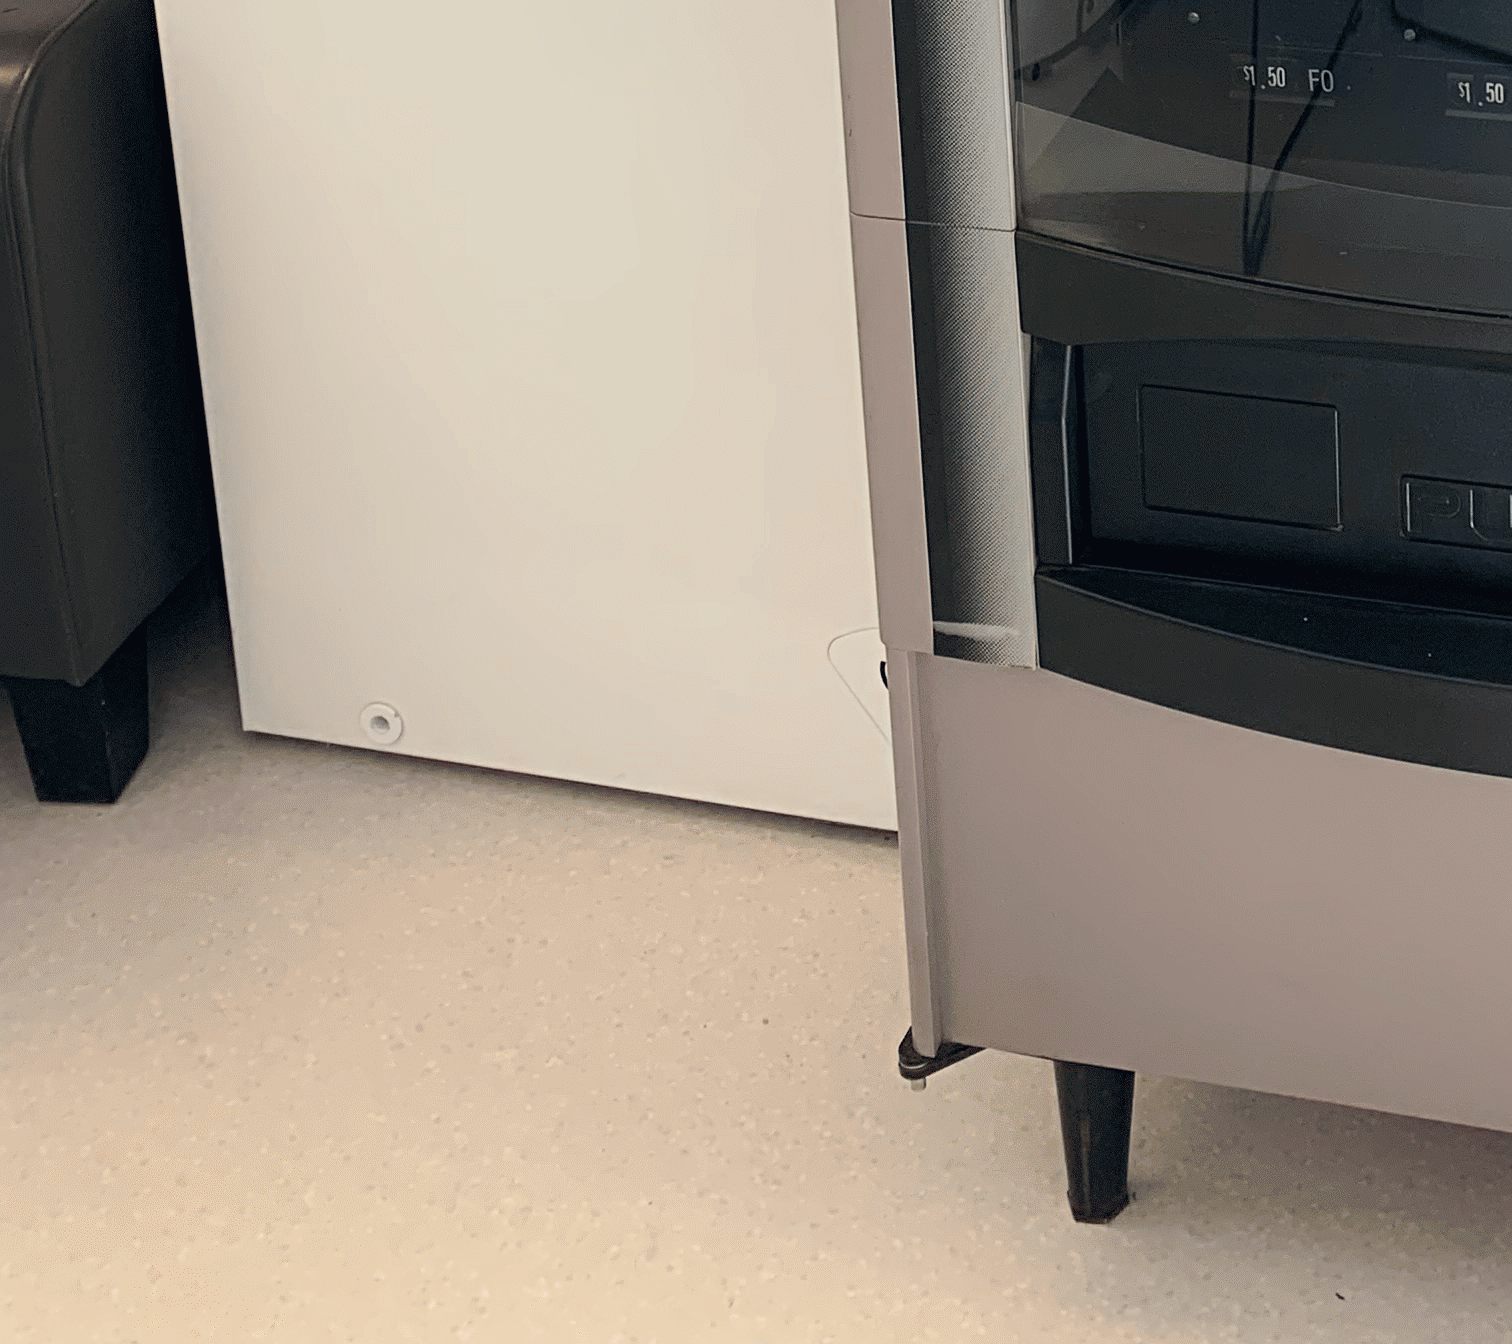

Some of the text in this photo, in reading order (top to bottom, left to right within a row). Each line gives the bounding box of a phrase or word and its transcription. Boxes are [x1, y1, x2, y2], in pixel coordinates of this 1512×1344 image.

[1243, 65, 1335, 93] $1.50 F0
[1459, 82, 1505, 108] $1.50
